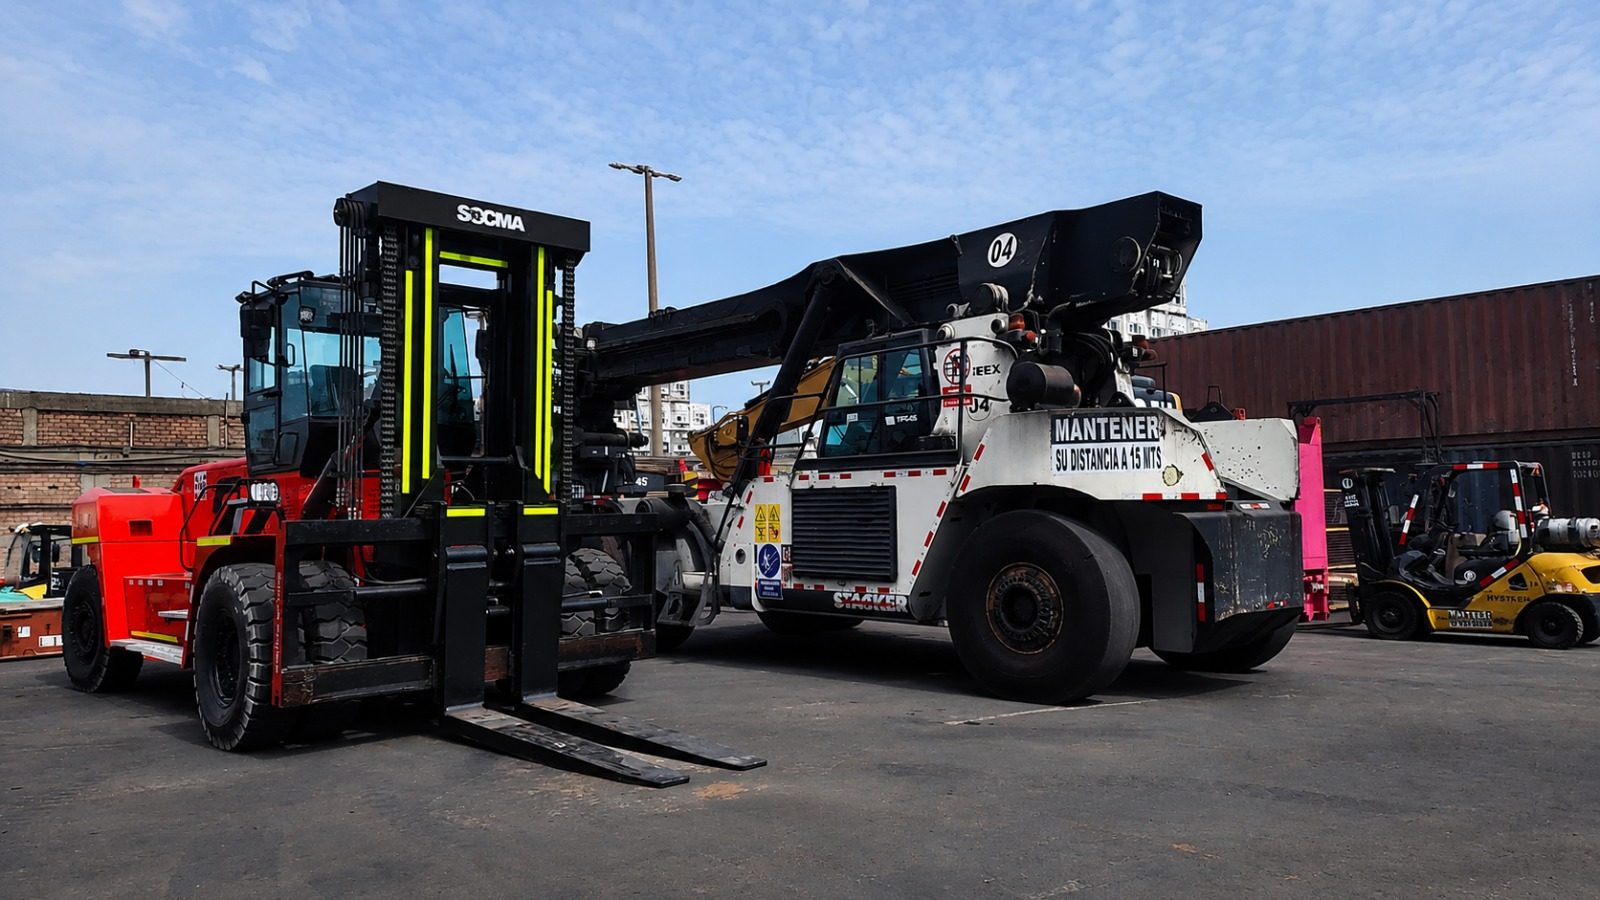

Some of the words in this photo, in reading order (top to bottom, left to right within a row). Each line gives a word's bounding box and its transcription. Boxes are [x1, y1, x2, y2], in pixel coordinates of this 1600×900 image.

[456, 204, 526, 232] SOCMA
[991, 236, 1013, 263] 04
[1055, 416, 1159, 442] MANTENER
[1055, 448, 1068, 472] SU
[1070, 447, 1119, 471] DISTANCIA
[1121, 446, 1128, 470] A
[1130, 444, 1141, 470] 15
[1143, 446, 1161, 469] MTS
[833, 592, 908, 612] STACKER
